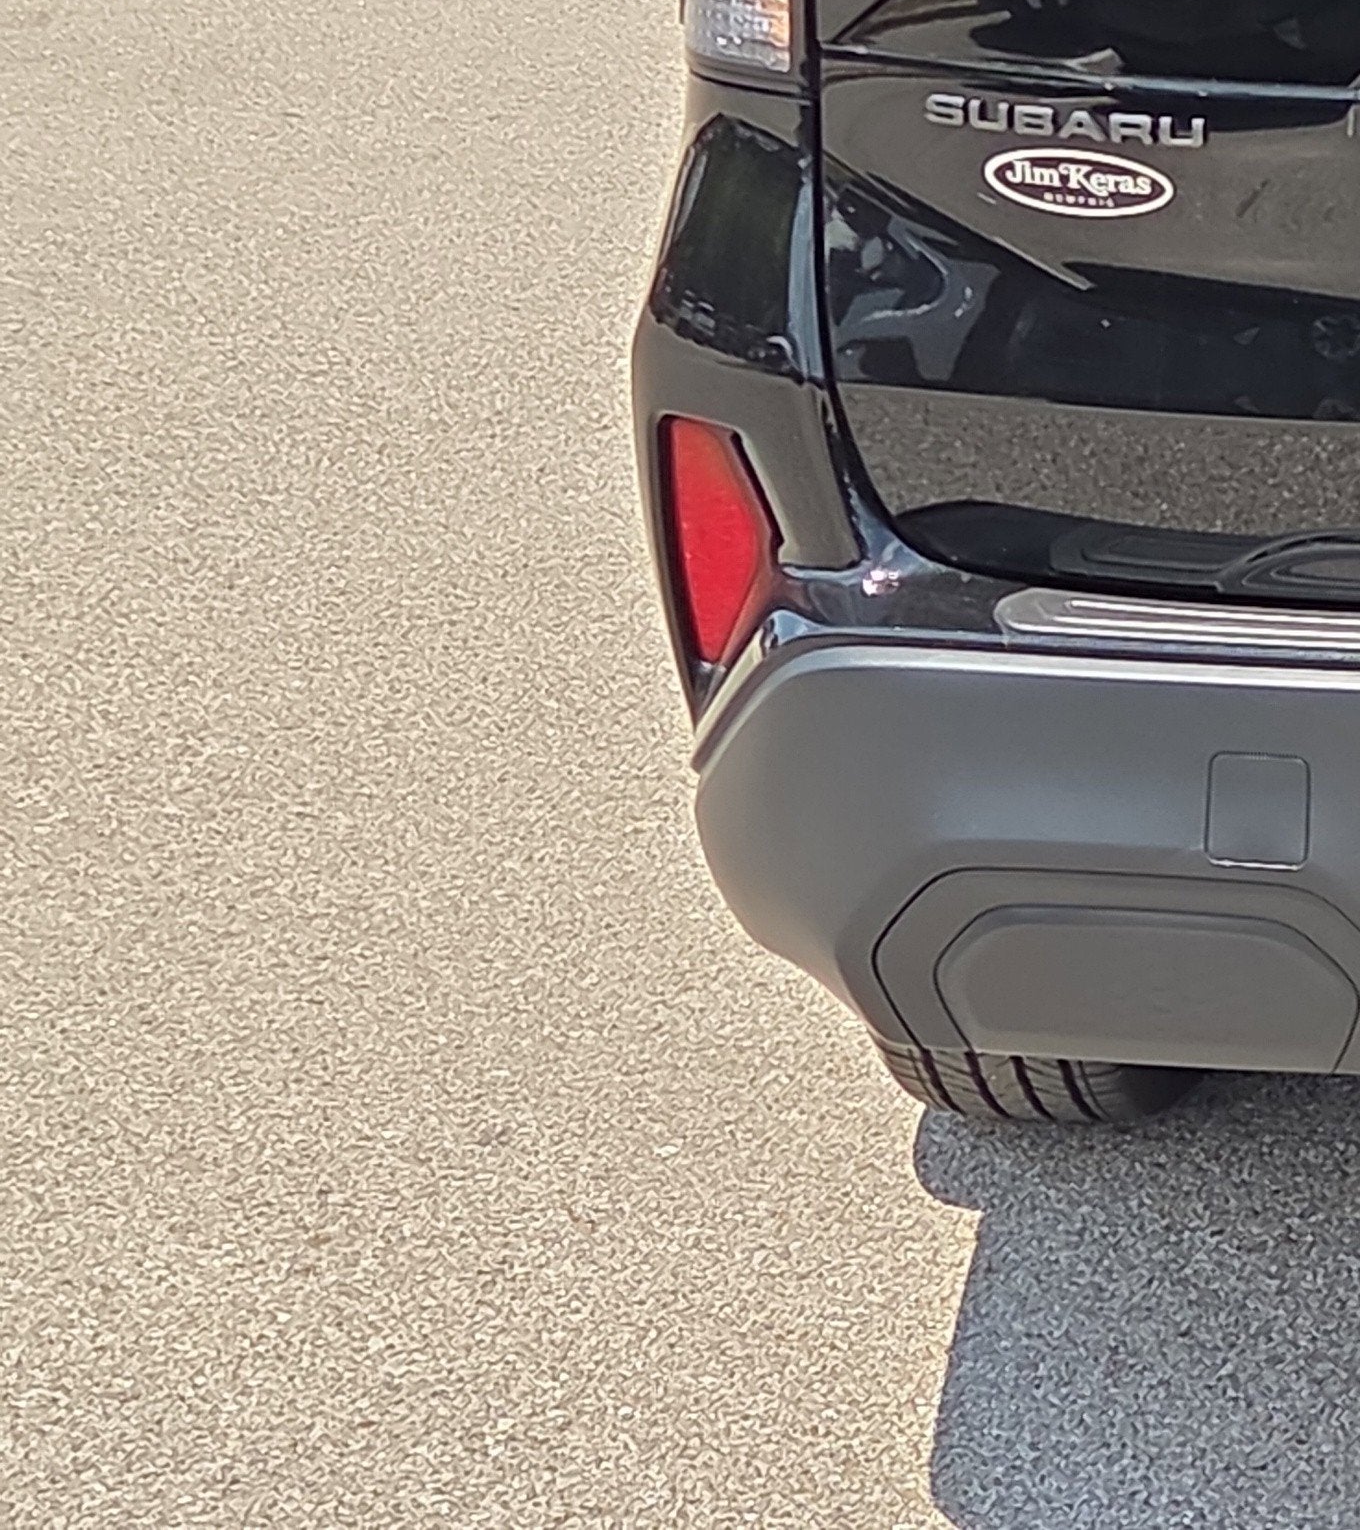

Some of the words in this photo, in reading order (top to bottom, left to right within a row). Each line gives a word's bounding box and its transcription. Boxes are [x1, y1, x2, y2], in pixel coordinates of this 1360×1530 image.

[925, 93, 1206, 149] SUBARU
[1005, 159, 1061, 187] Jim
[1059, 164, 1152, 197] Keras
